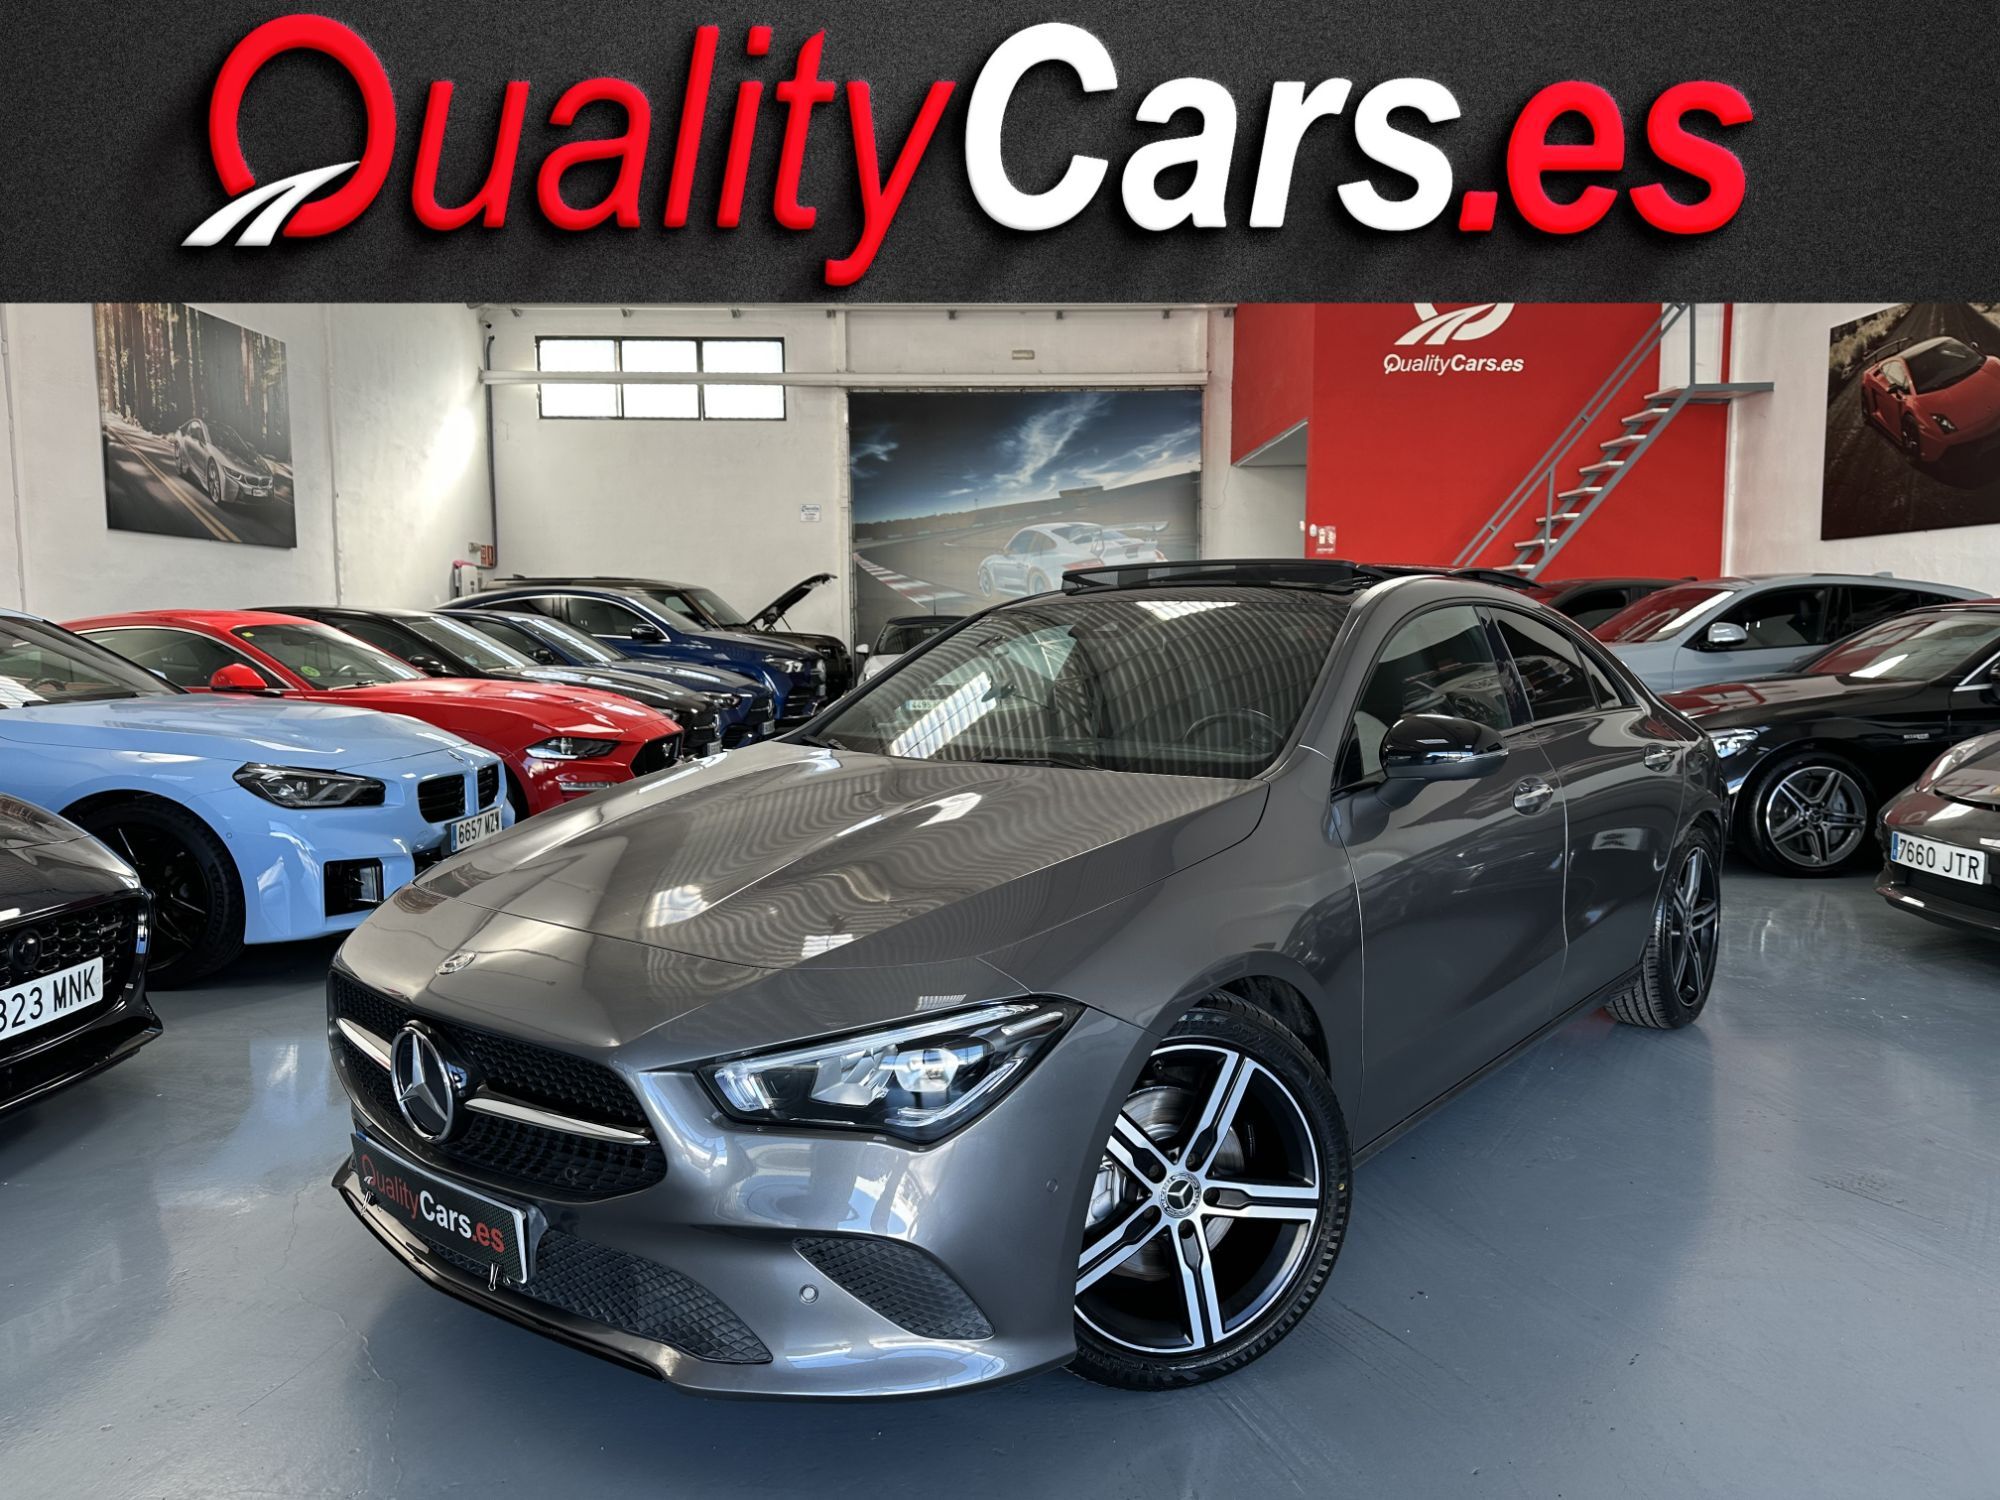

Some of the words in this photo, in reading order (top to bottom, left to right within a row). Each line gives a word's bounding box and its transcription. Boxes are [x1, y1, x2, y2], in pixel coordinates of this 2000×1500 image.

[1383, 353, 1525, 376] QualityCars.es
[458, 817, 483, 844] 6657
[1898, 839, 1936, 868] 7660
[1942, 851, 1980, 880] JTR
[53, 965, 96, 1013] MNK
[361, 1154, 505, 1253] QualityCars.es
